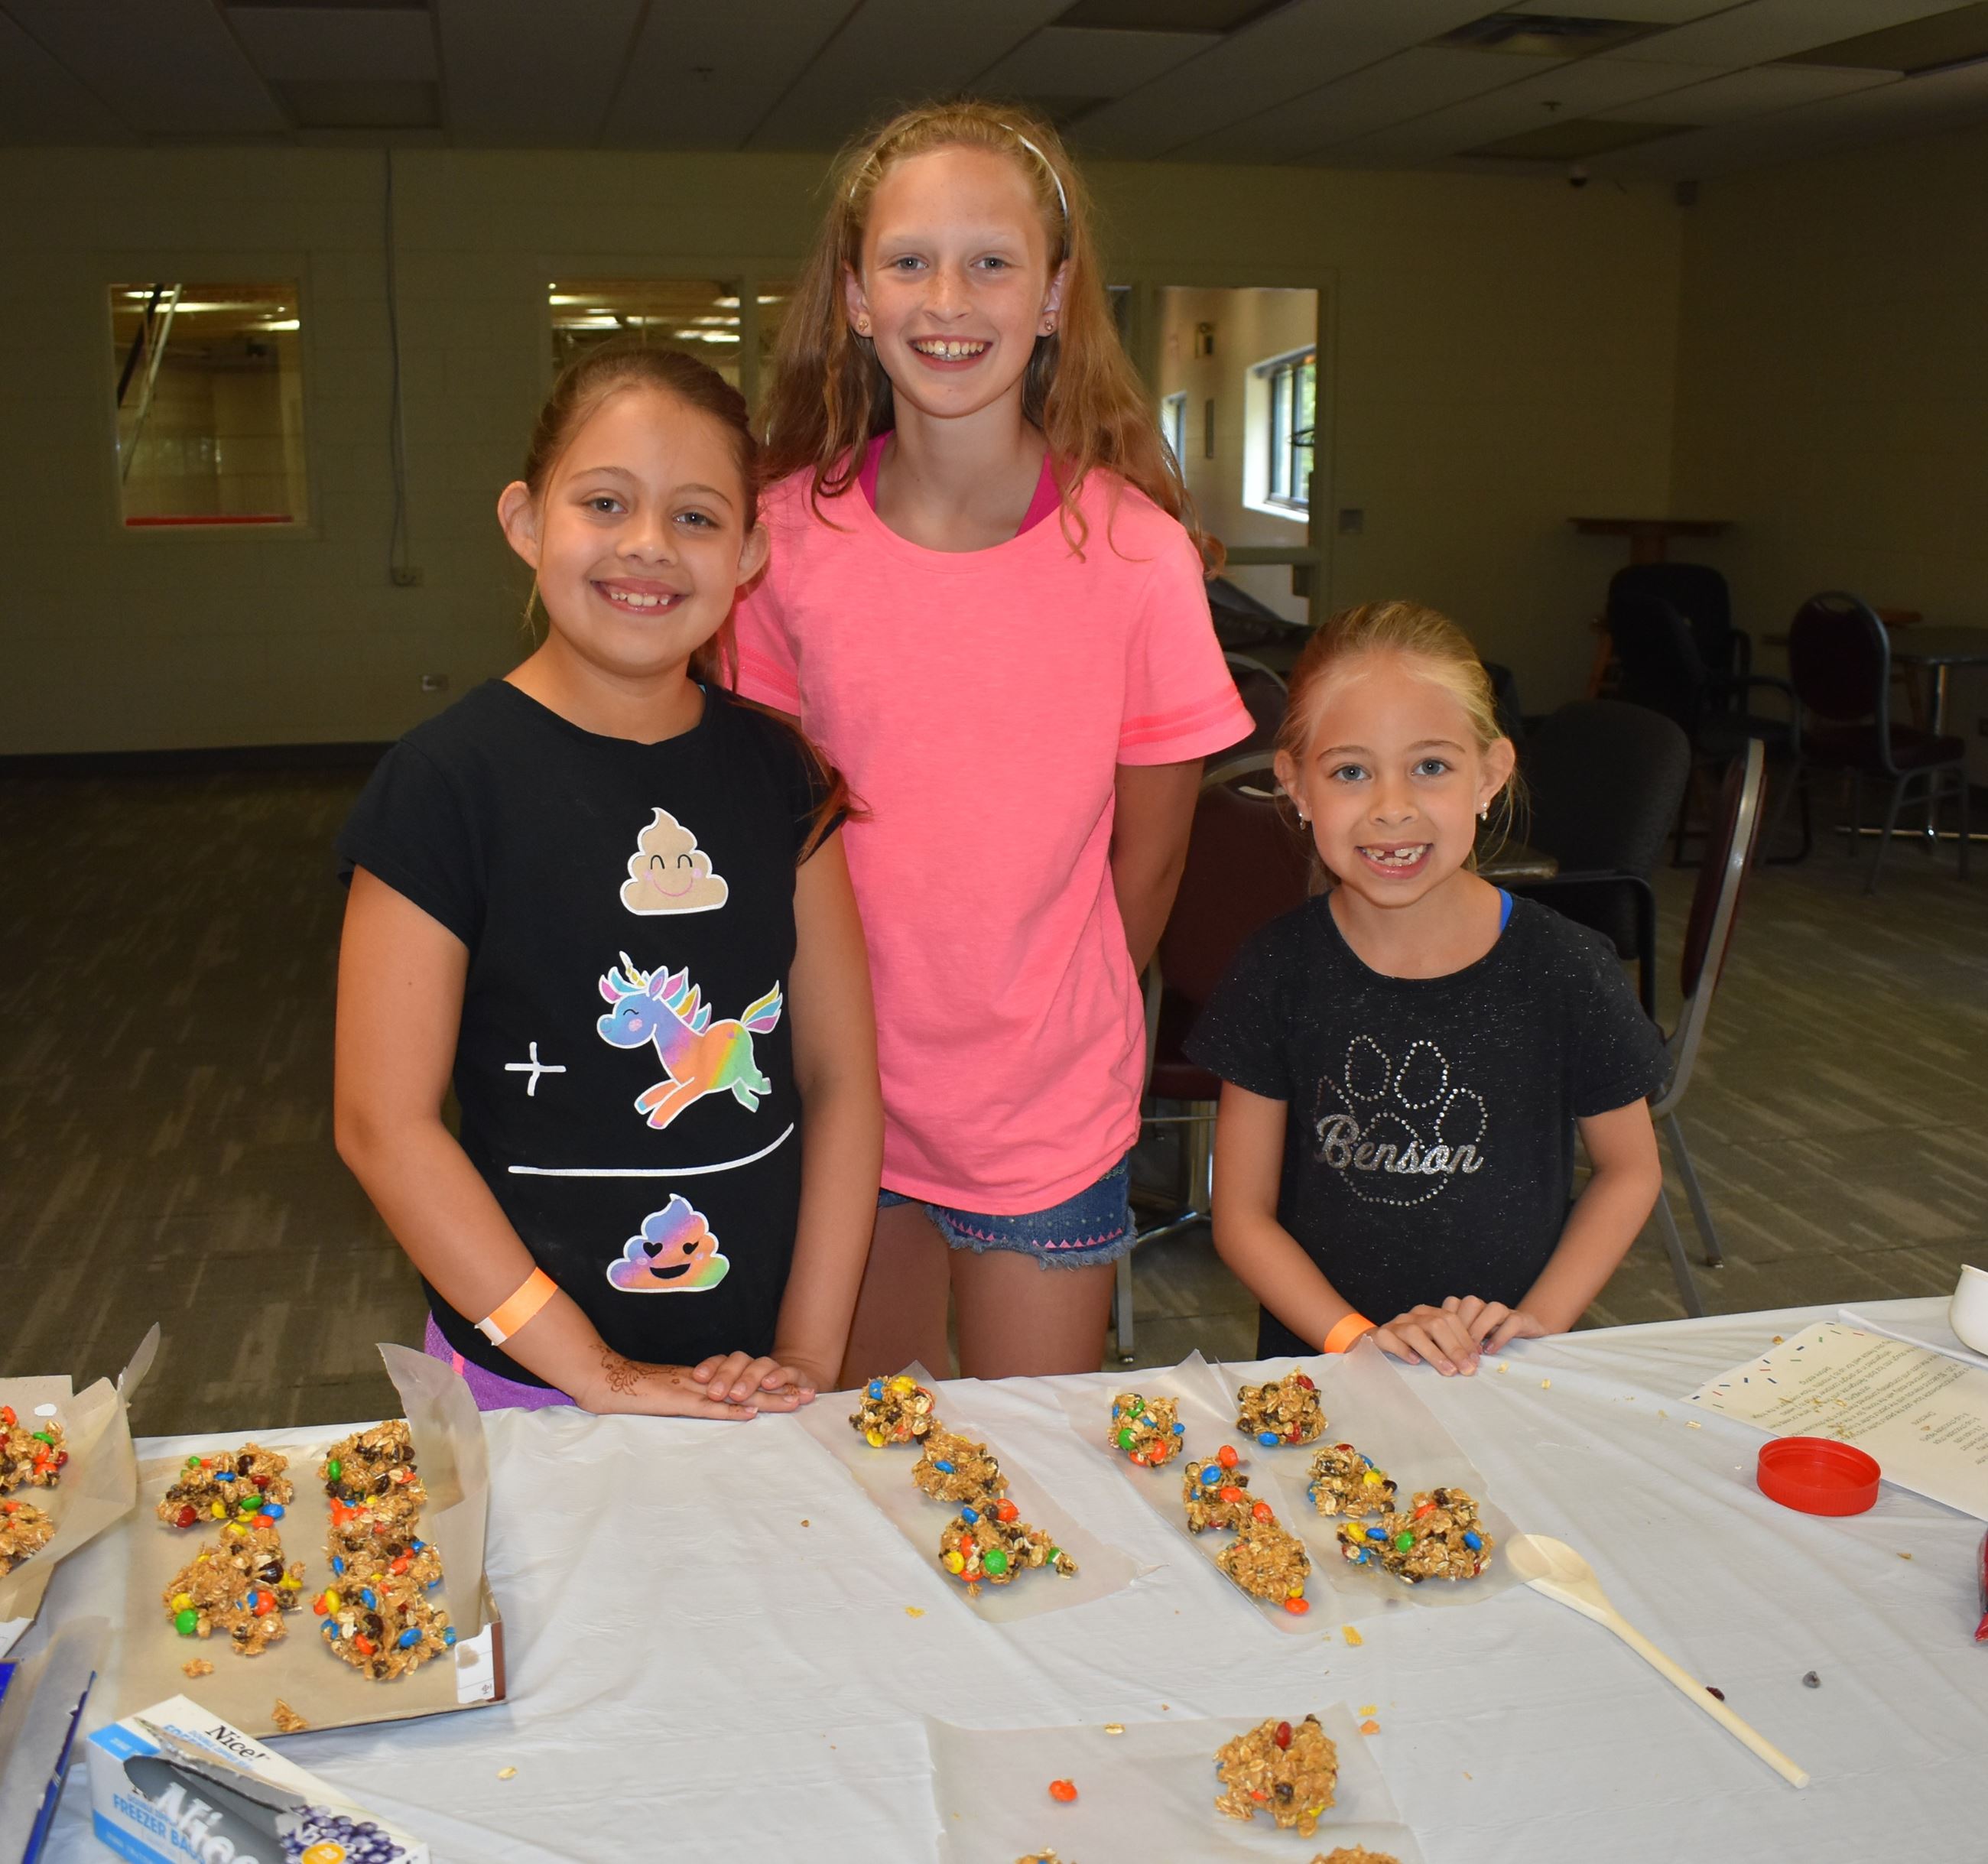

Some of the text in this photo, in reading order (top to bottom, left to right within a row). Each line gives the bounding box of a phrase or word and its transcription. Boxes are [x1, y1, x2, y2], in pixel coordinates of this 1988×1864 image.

[1315, 1113, 1484, 1175] Benson
[205, 1725, 265, 1760] Nice!
[113, 1793, 167, 1836] FREEZER
[155, 1781, 259, 1864] Nic
